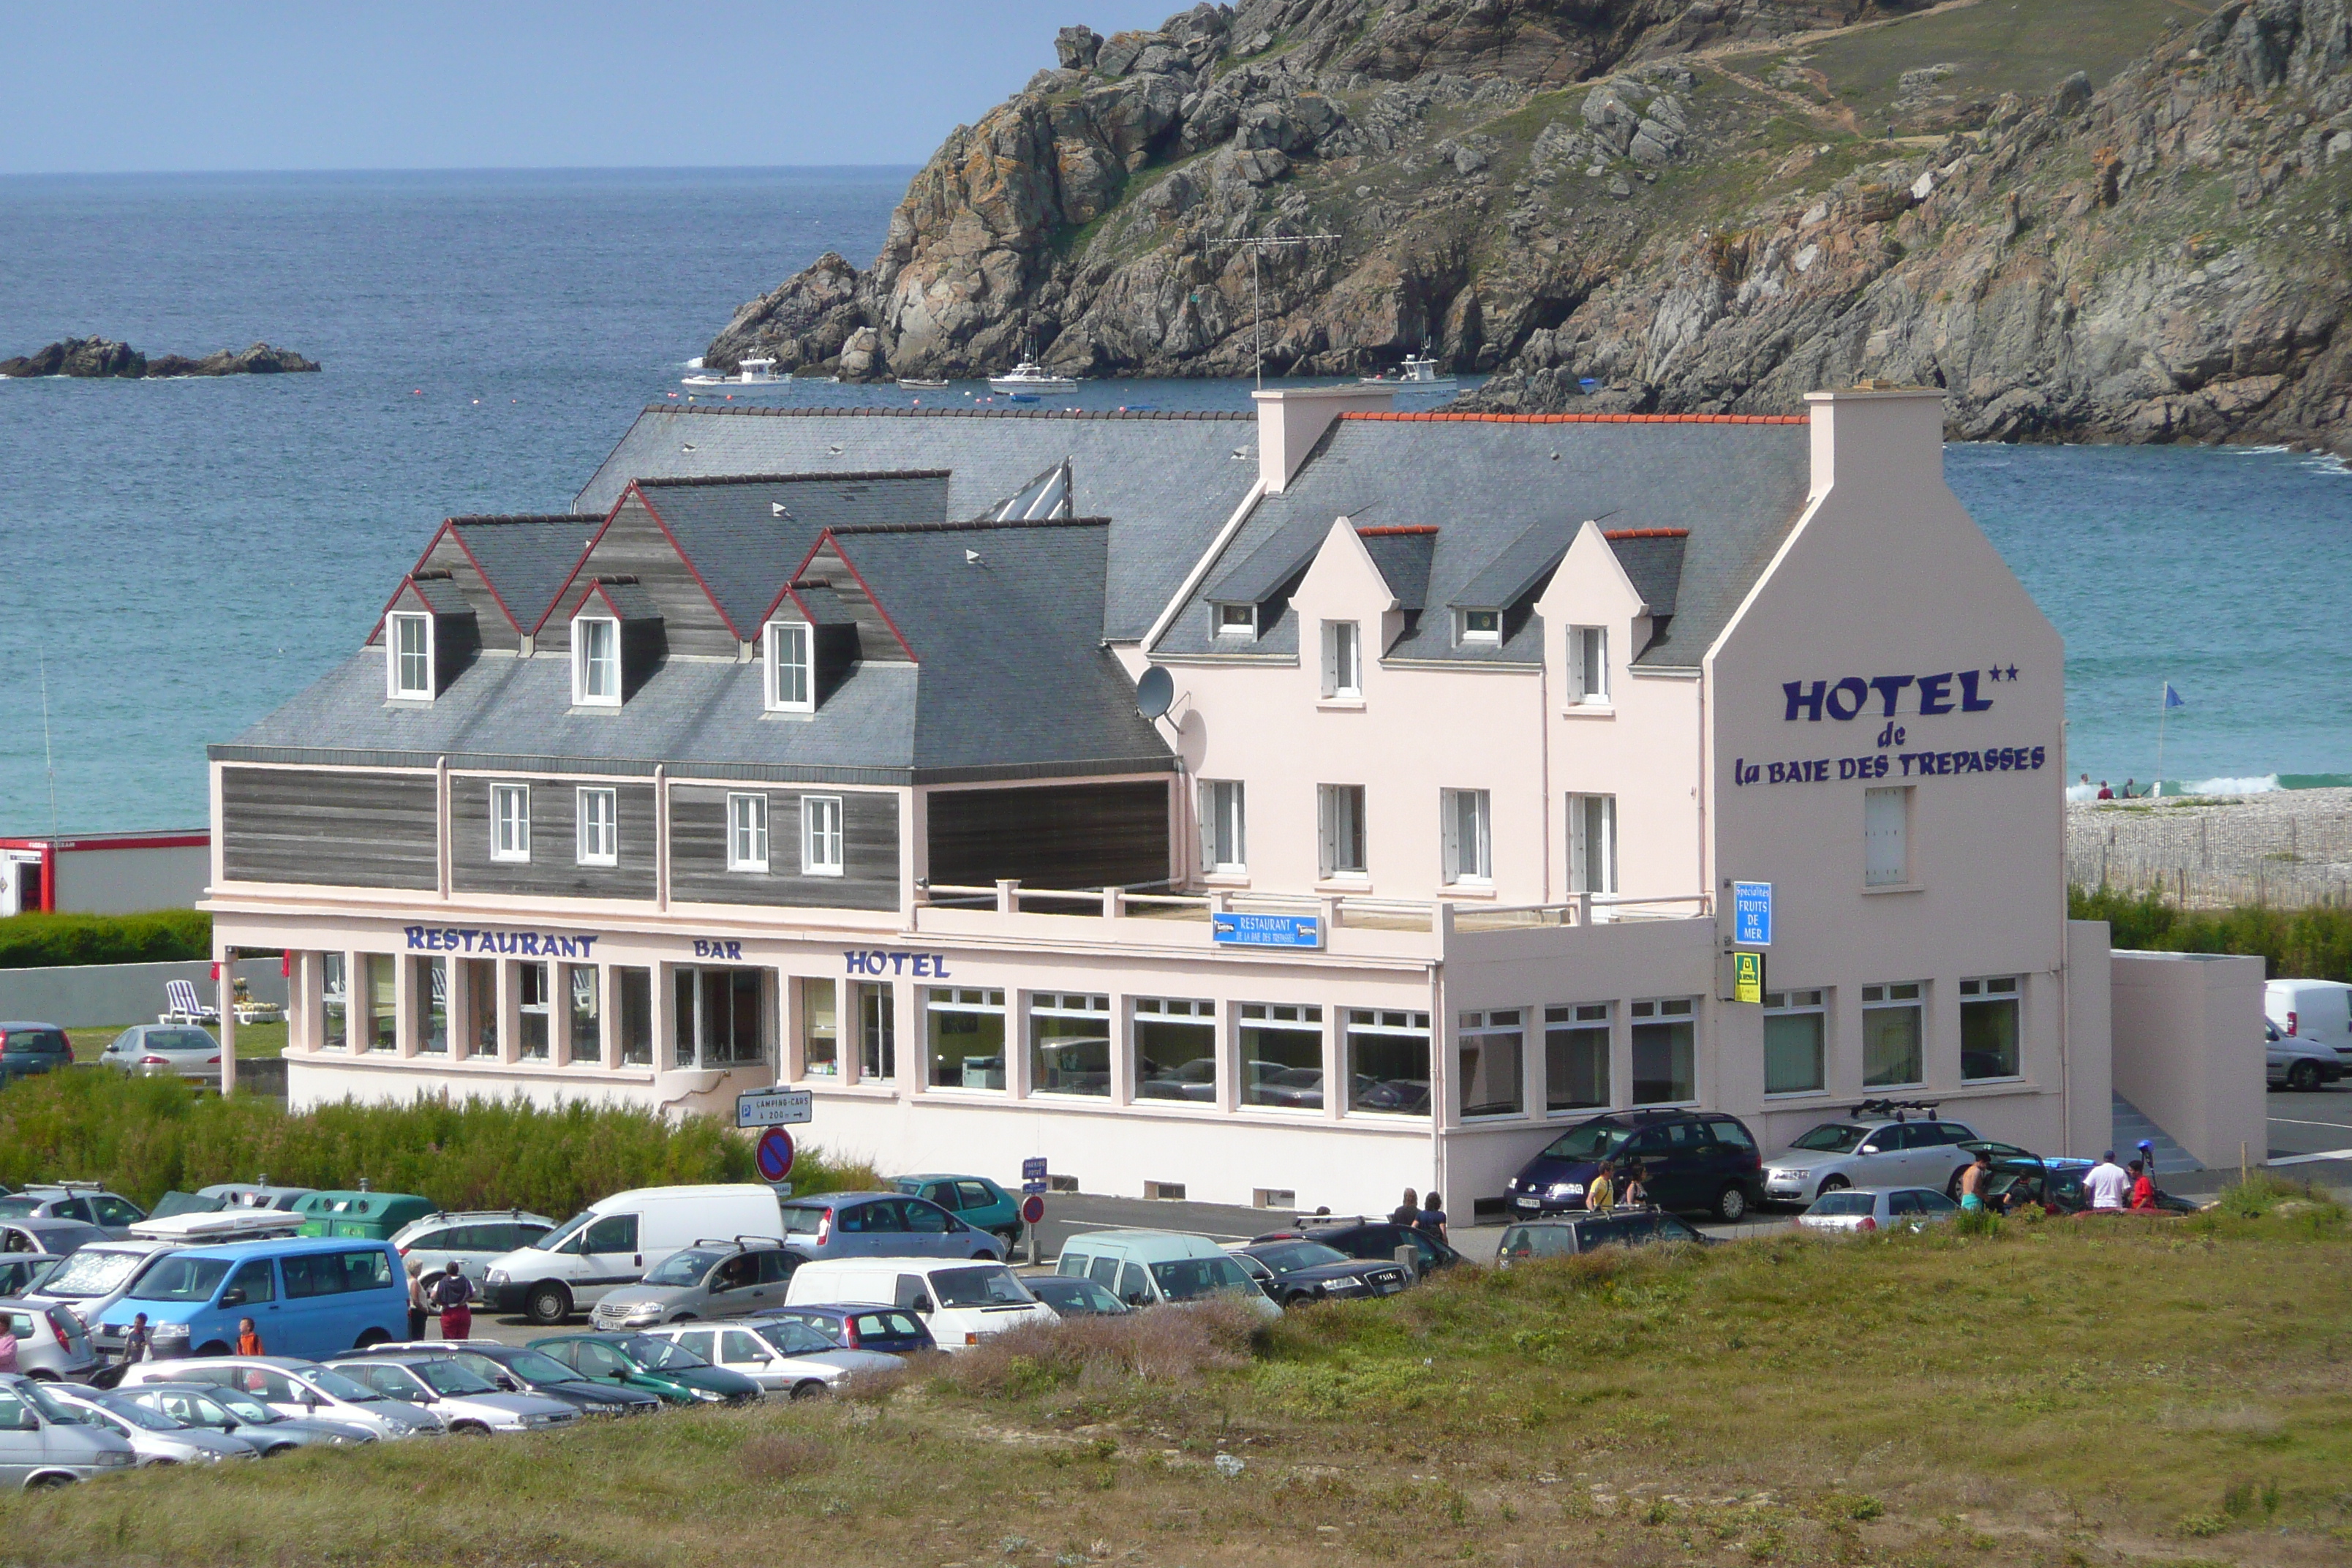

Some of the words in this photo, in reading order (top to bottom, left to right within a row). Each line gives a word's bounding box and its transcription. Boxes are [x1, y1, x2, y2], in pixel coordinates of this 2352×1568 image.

[1782, 669, 1993, 722] HOTEL
[1877, 720, 1906, 748] de
[1768, 758, 1830, 785] BAIE
[1836, 754, 1889, 780] DES
[1896, 745, 2046, 776] TREPASSES
[1739, 900, 1768, 912] FRUITS
[1240, 917, 1291, 931] RESTAURANT
[1747, 914, 1759, 926] DE
[1744, 927, 1763, 939] MER
[404, 926, 598, 958] RESTAURANT
[693, 940, 743, 960] BAR
[845, 951, 951, 979] HOTEL
